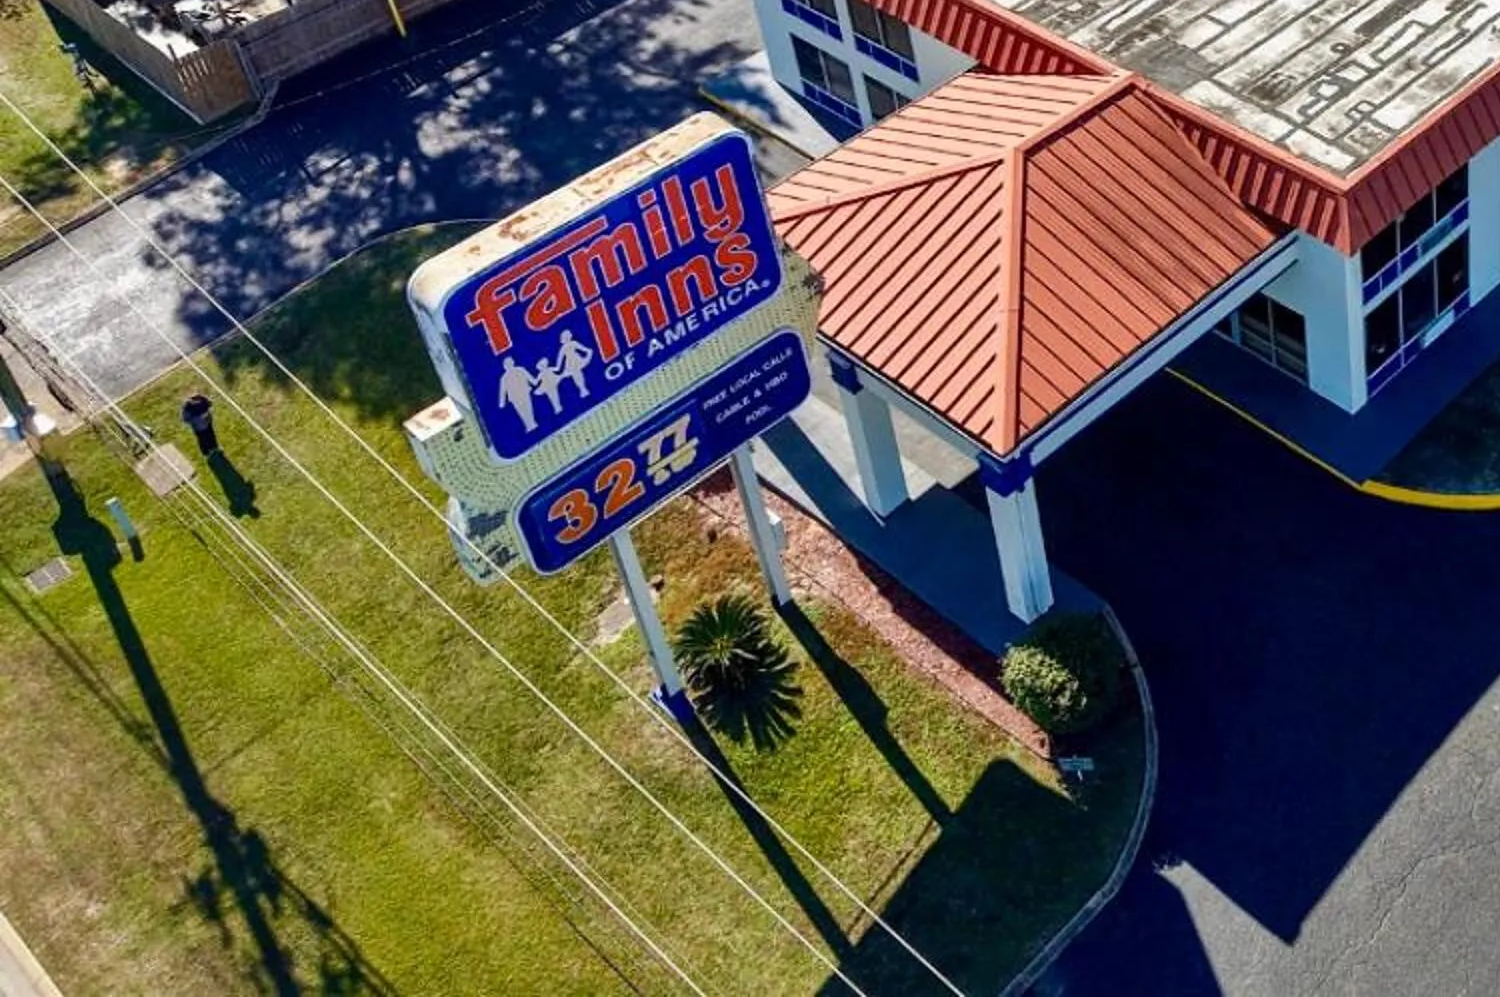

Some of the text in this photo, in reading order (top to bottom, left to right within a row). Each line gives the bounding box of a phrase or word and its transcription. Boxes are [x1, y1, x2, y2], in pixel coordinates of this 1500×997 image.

[604, 350, 635, 381] OF
[703, 389, 727, 411] FREE
[729, 368, 762, 393] LOCAL
[715, 395, 750, 423] CABLE
[547, 458, 646, 544] 32
[637, 413, 691, 467] 77
